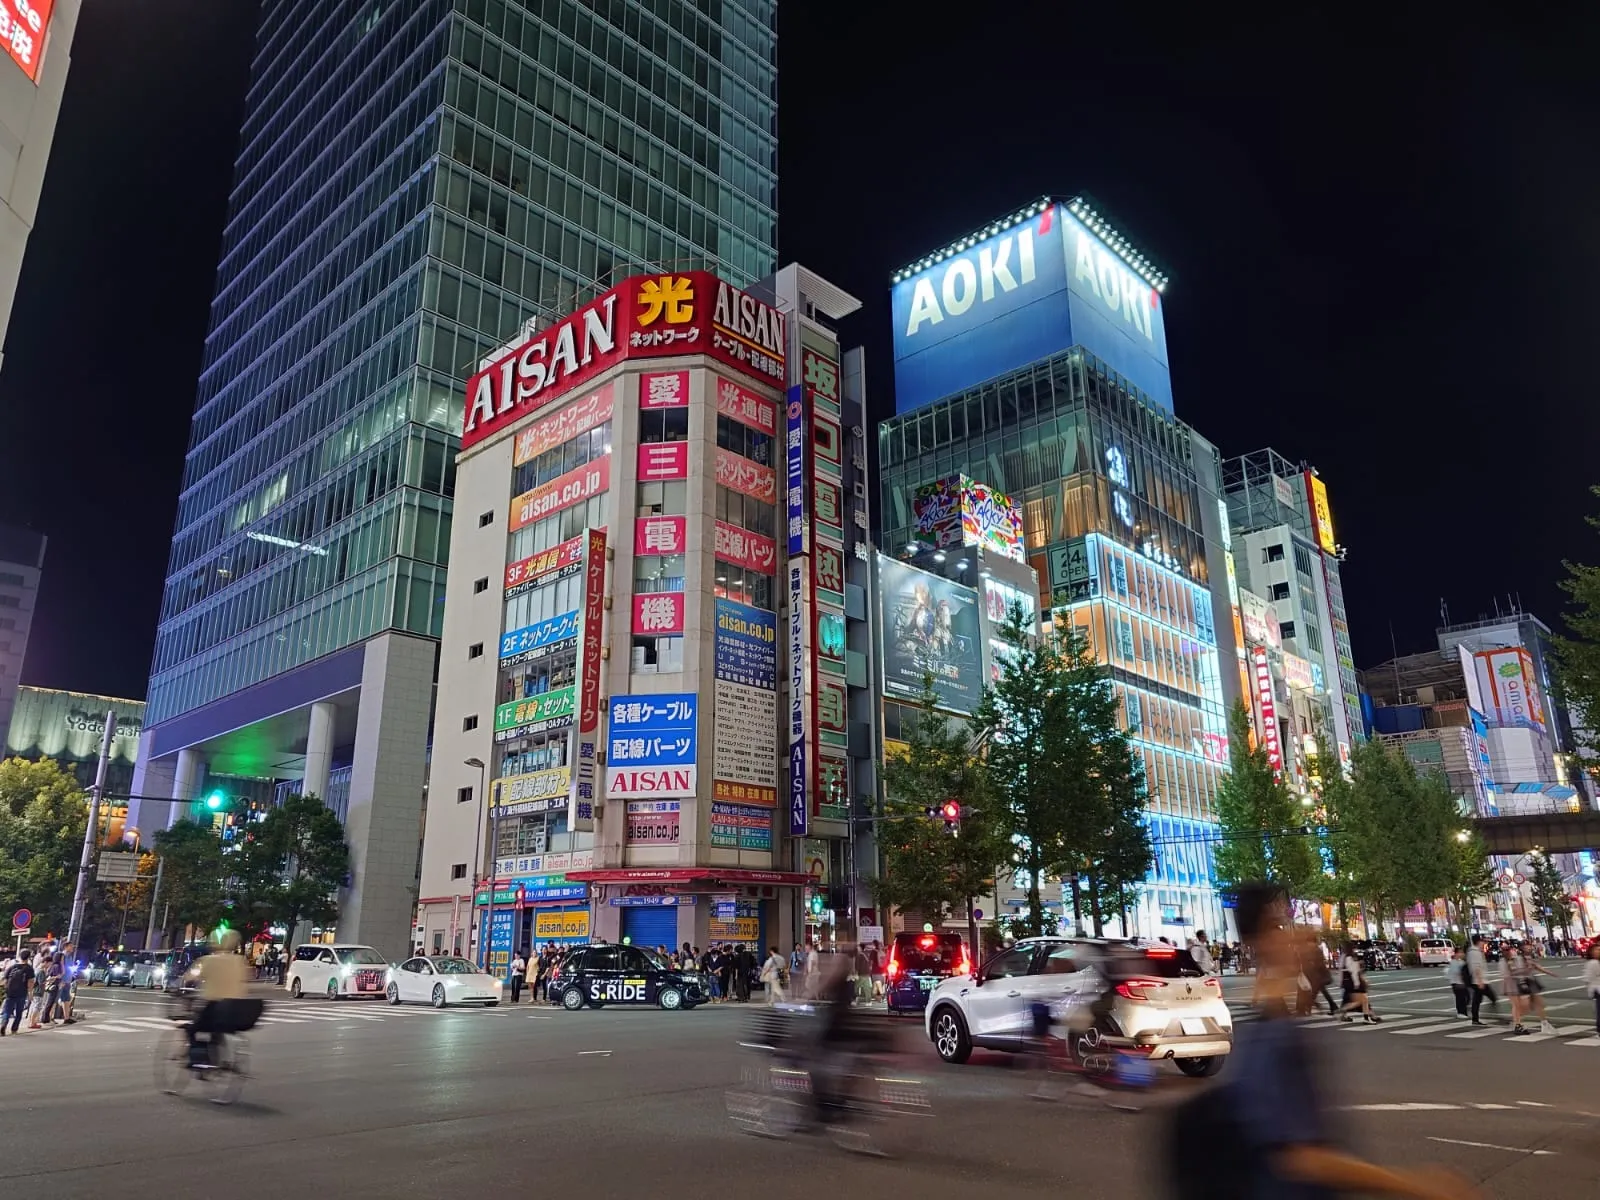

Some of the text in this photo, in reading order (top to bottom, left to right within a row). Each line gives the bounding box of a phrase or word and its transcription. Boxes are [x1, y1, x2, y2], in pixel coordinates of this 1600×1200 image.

[637, 276, 694, 327] 光
[714, 281, 784, 356] AISAN
[630, 327, 699, 348] ネットワーク
[465, 294, 617, 433] AISAN
[720, 383, 773, 428] 光通信
[716, 455, 775, 497] ネットワーク
[520, 471, 600, 523] aisan.co.jp
[715, 526, 774, 567] 配線パーツ
[509, 565, 522, 582] 3F
[719, 613, 774, 642] aisan.co.jp
[503, 636, 517, 653] 2F
[499, 708, 512, 725] 1F
[613, 701, 693, 725] 各種ケーブル
[612, 738, 690, 760] 配線パーツ
[577, 742, 594, 820] 愛三電機
[610, 770, 690, 793] AISAN
[793, 746, 803, 826] AISAN
[629, 821, 679, 842] aisan.co.jp
[539, 920, 586, 935] aisan.co.jp
